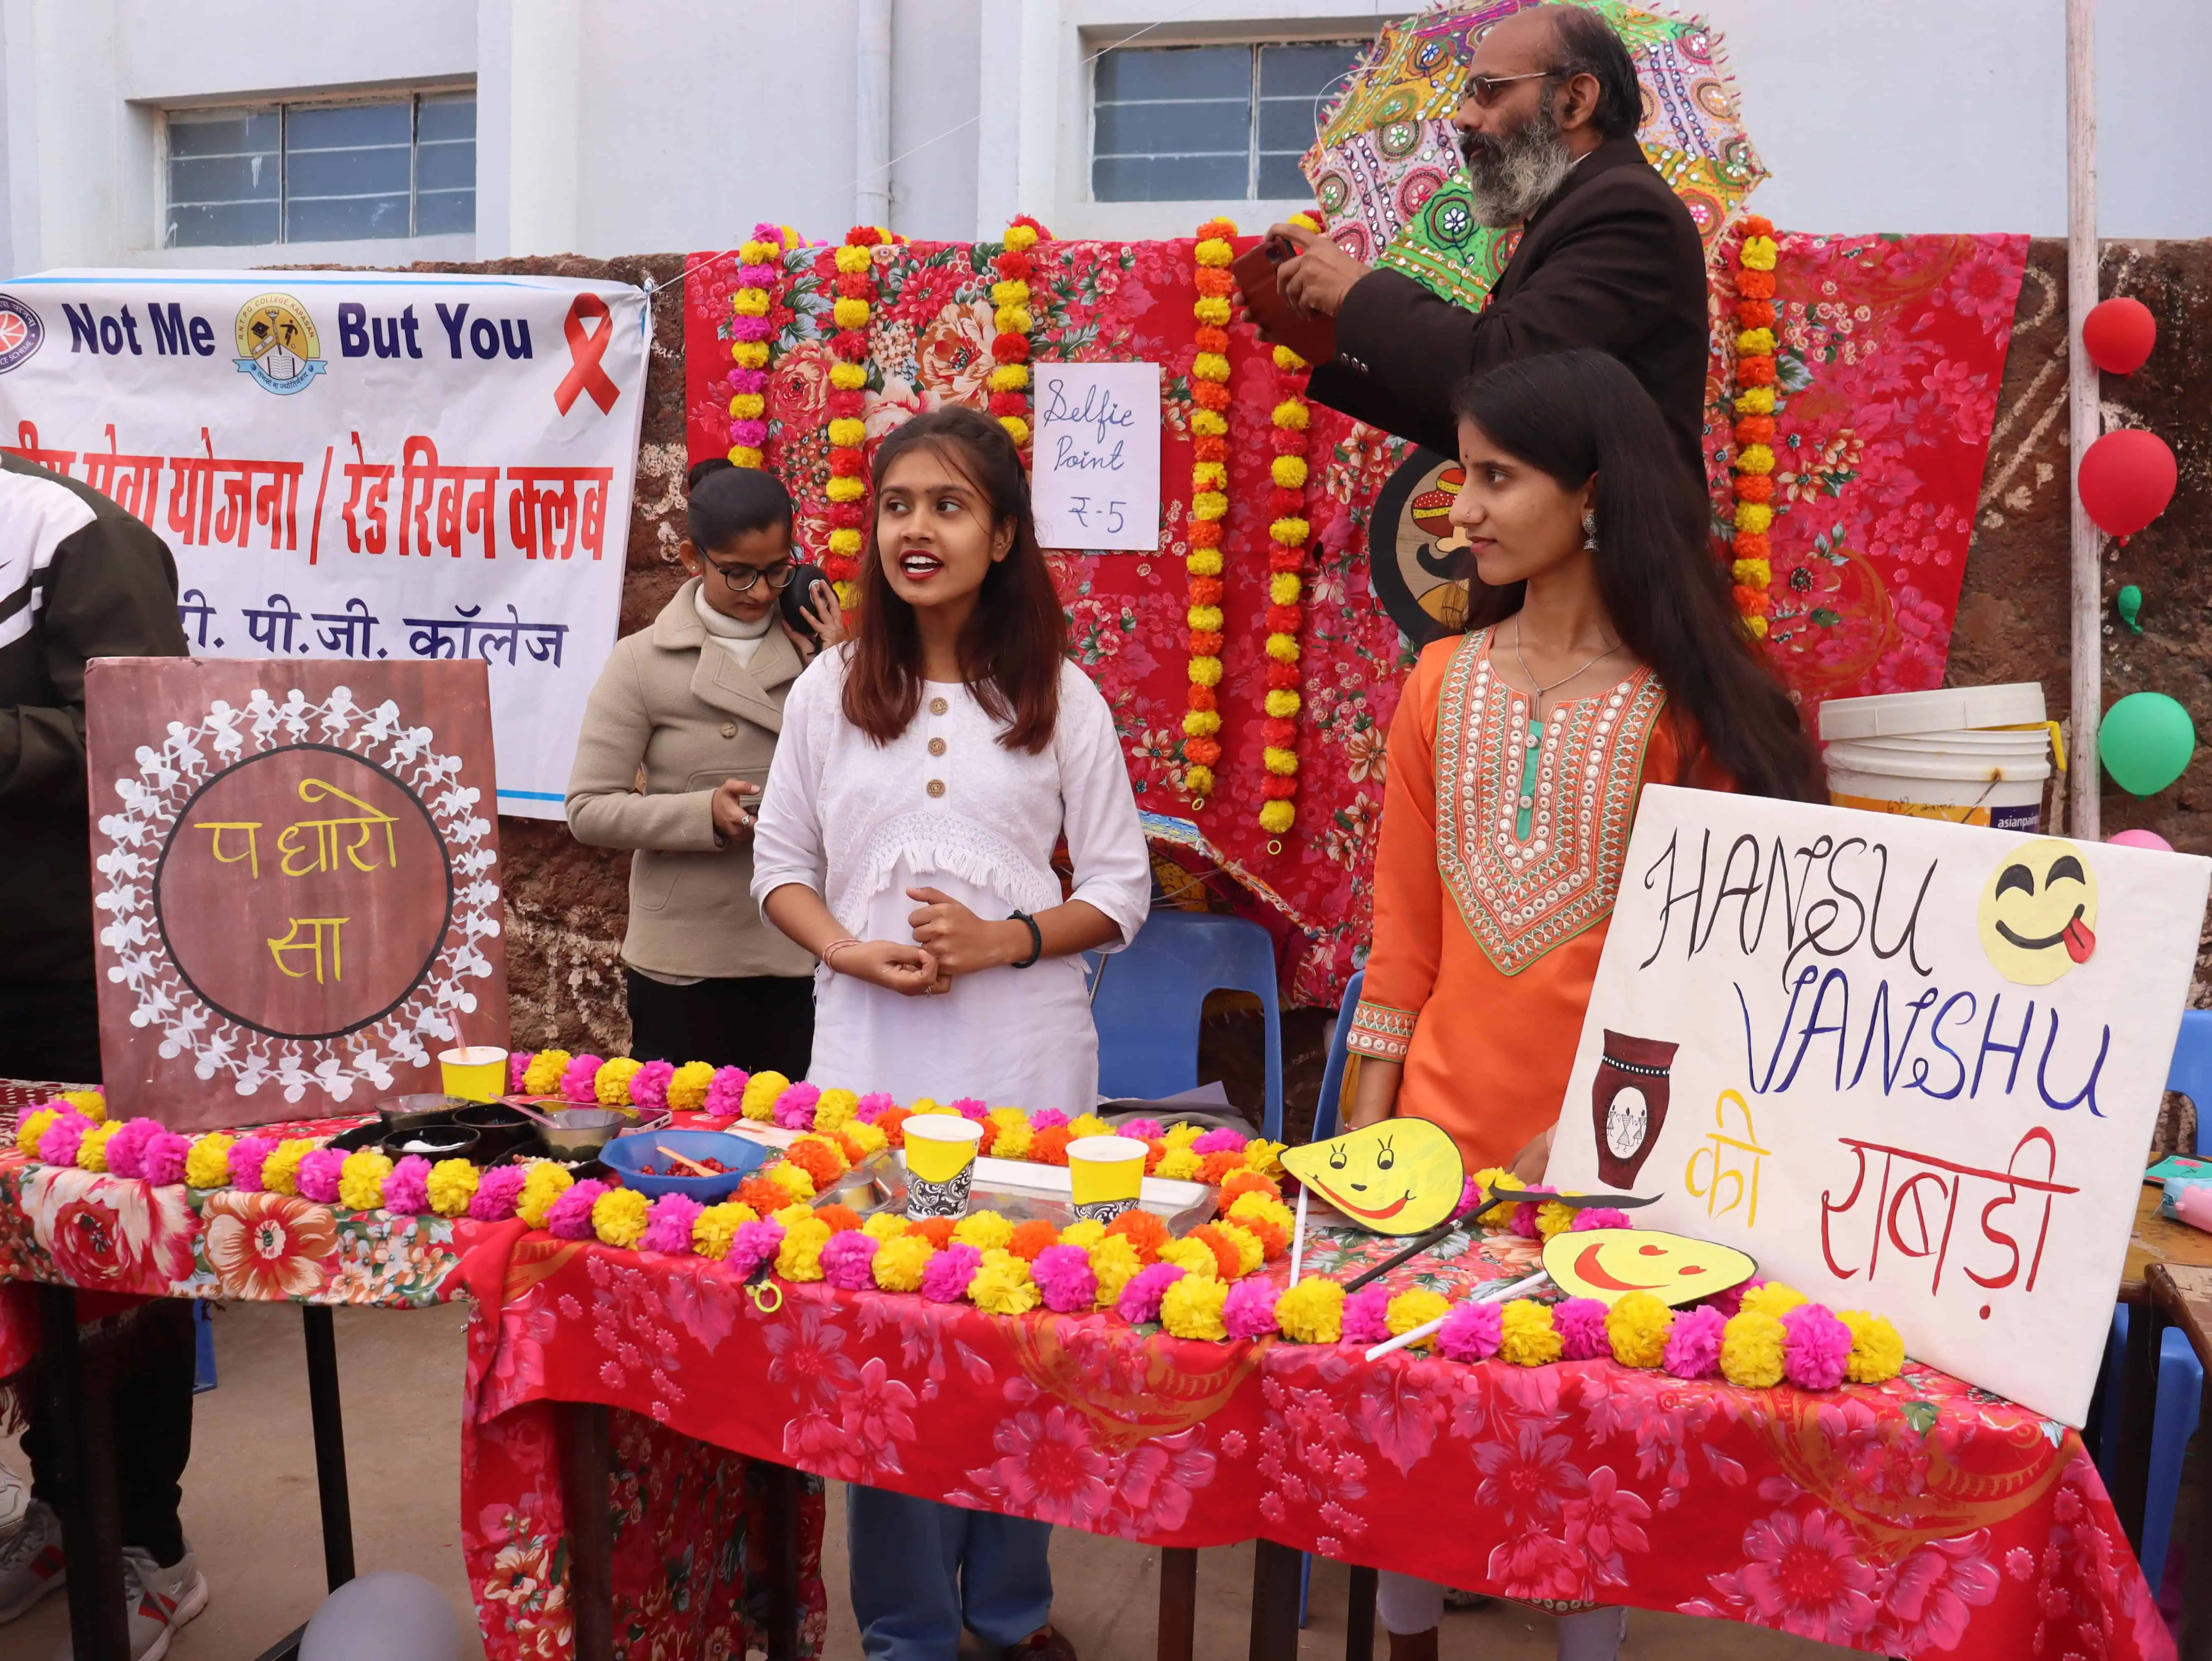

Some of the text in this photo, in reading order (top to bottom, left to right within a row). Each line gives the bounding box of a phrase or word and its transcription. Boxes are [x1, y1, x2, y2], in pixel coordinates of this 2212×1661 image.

[9, 340, 34, 361] SCHEME
[61, 303, 533, 360] Not Me But You
[291, 302, 315, 338] KAPASAN
[1043, 379, 1135, 444] Selfie
[1054, 435, 1124, 471] Point
[168, 427, 303, 550] योजना
[342, 432, 395, 554] रेड
[399, 436, 500, 559] रिबन
[507, 466, 613, 561] क्लब
[403, 604, 569, 668] कॉलेज
[1639, 827, 1938, 993] HANSU
[267, 917, 351, 984] सा
[1733, 965, 2110, 1118] VANSHU
[1685, 1088, 1772, 1229] की
